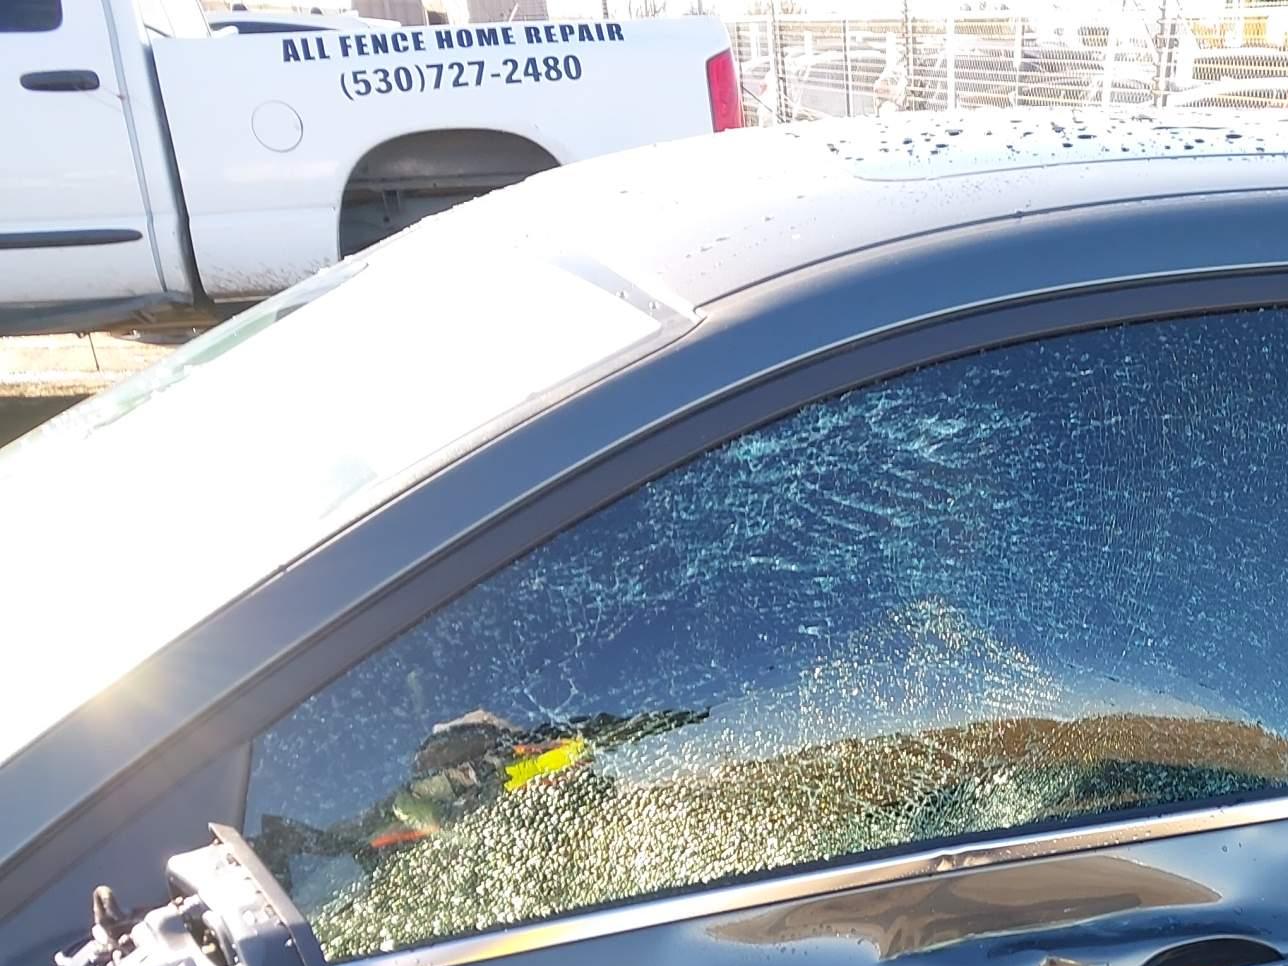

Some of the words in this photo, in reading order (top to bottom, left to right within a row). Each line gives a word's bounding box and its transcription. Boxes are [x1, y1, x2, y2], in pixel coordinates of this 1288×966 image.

[282, 35, 331, 62] ALL
[338, 30, 426, 58] FENCE
[435, 26, 517, 50] HOME
[525, 22, 625, 44] REPAIR
[340, 54, 583, 101] (530)727-2480
